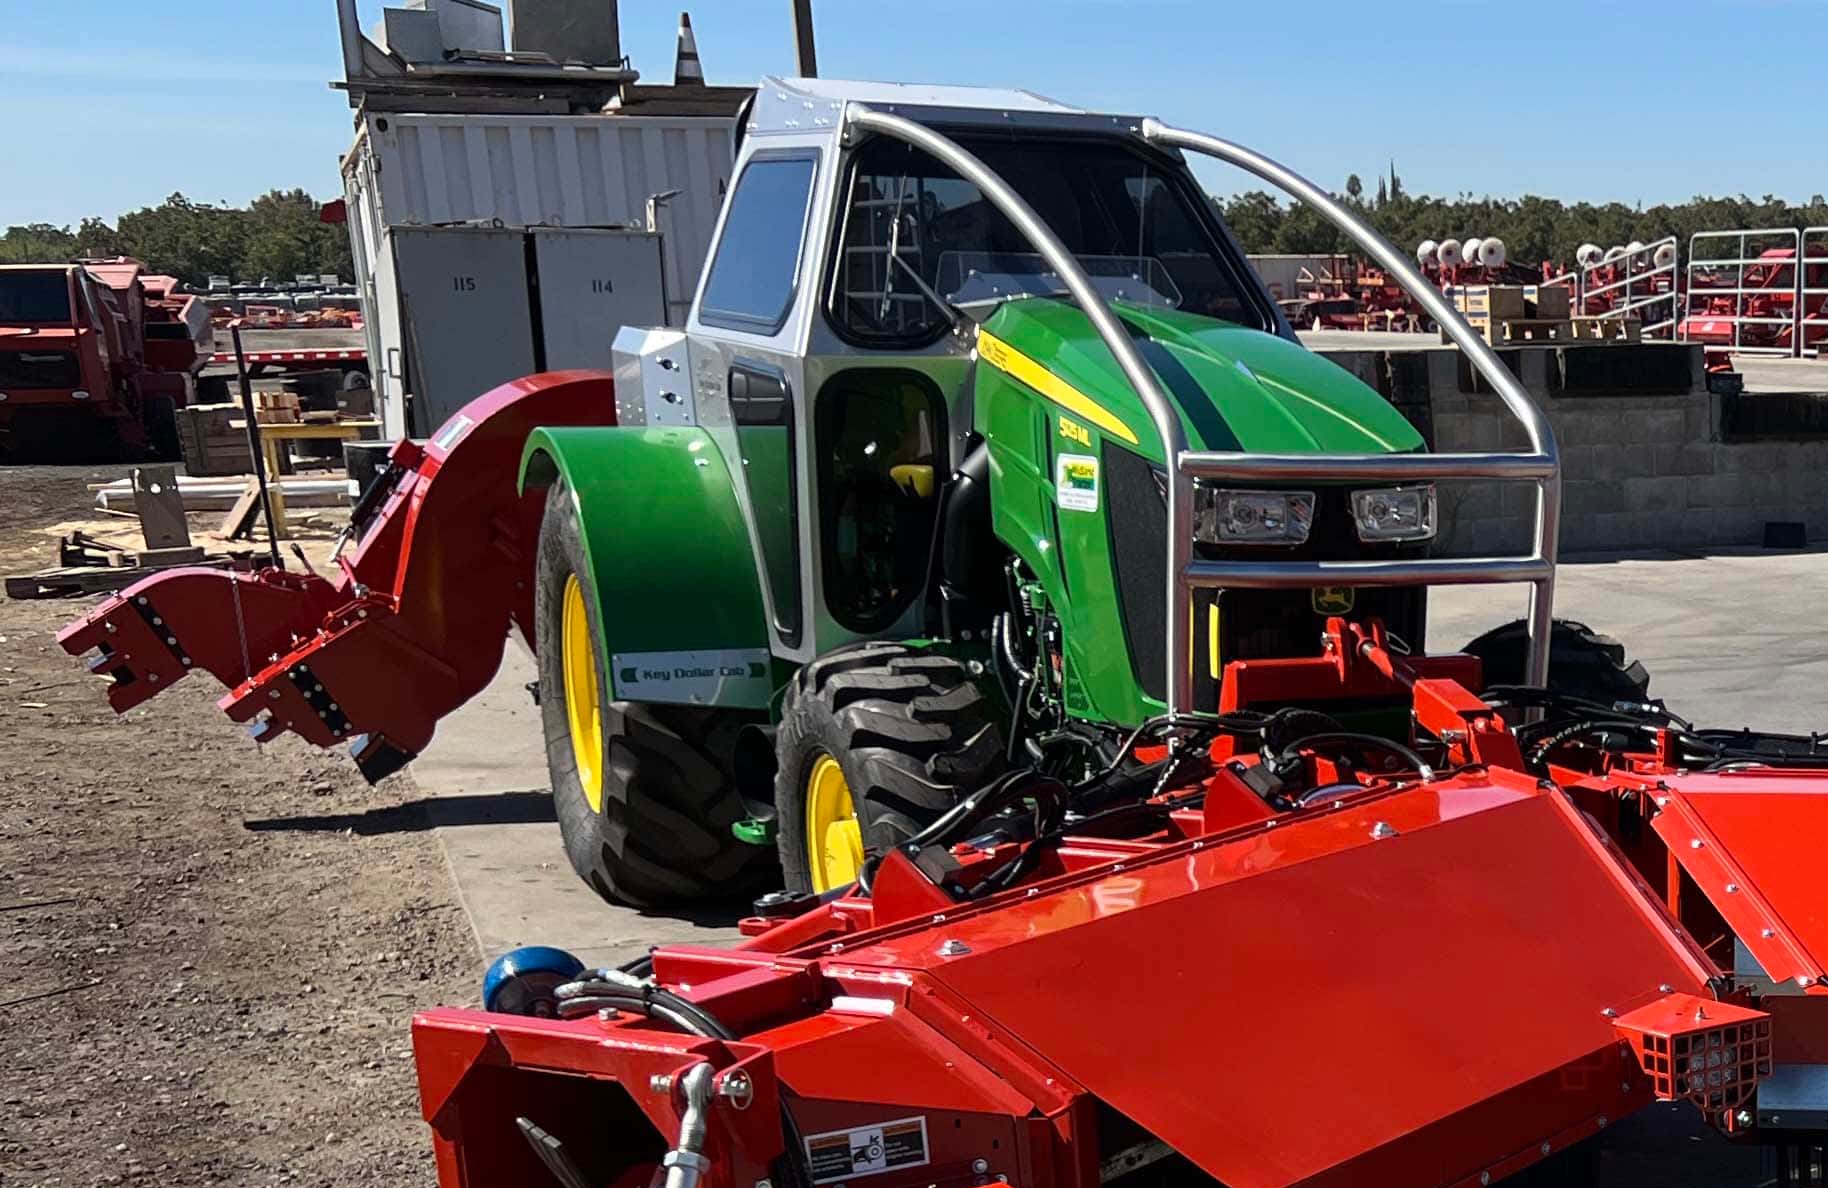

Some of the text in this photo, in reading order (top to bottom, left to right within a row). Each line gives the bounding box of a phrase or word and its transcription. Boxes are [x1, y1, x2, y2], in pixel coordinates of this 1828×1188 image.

[453, 277, 476, 291] 115
[592, 279, 613, 293] 114
[643, 666, 745, 681] Key Dollar Cab
